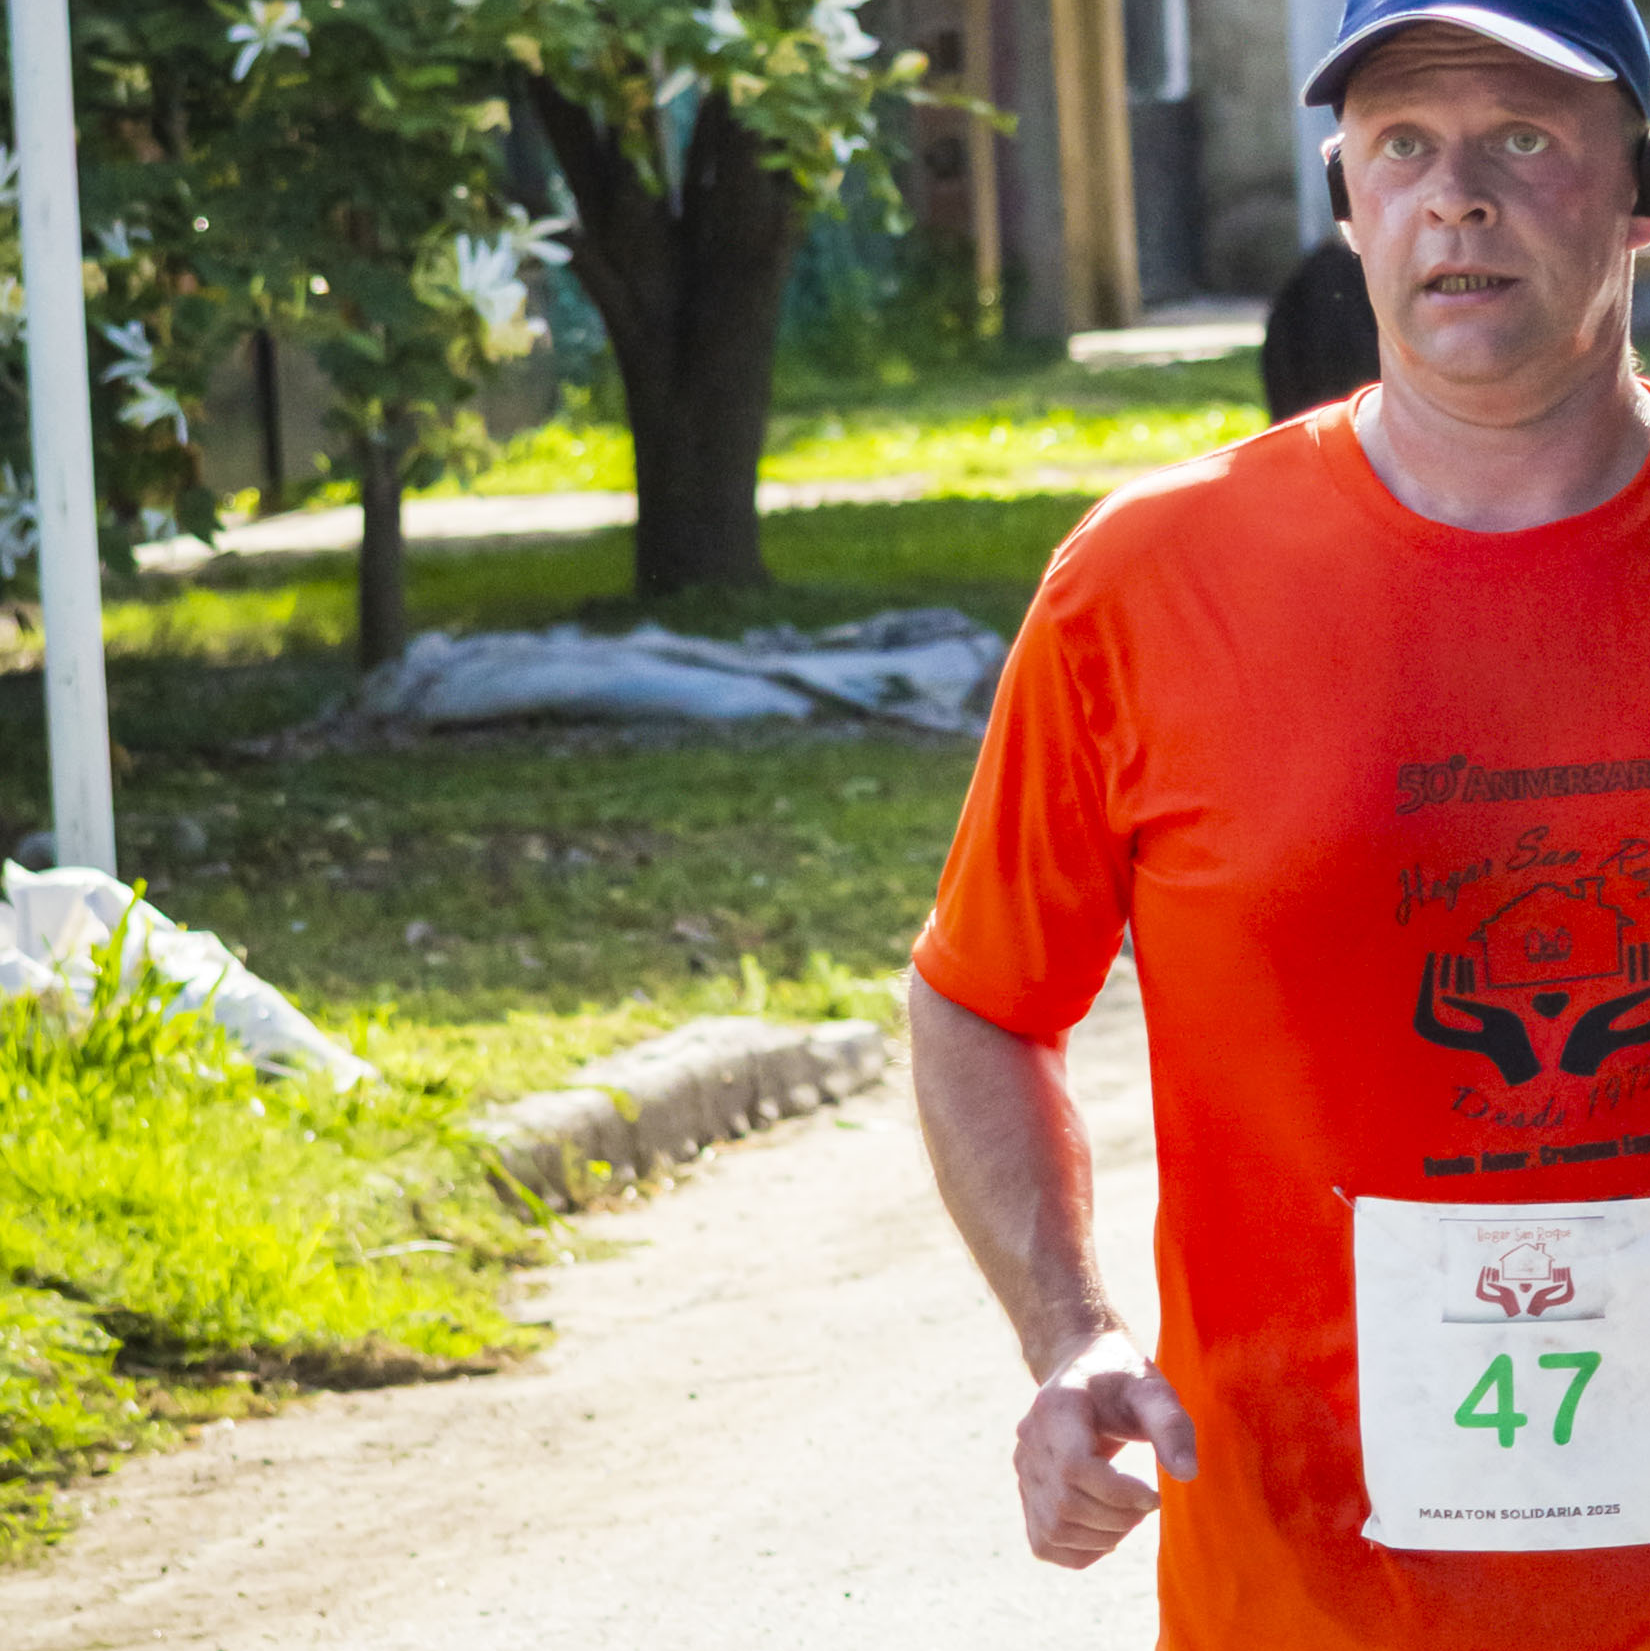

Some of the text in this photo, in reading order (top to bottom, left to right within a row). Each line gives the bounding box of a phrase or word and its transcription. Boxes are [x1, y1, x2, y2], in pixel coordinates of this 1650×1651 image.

[1506, 825, 1583, 871] San
[1451, 1085, 1567, 1128] Desde
[1454, 1351, 1602, 1449] 47
[1419, 1503, 1621, 1520] MARATON SOLIDARIA 2025
